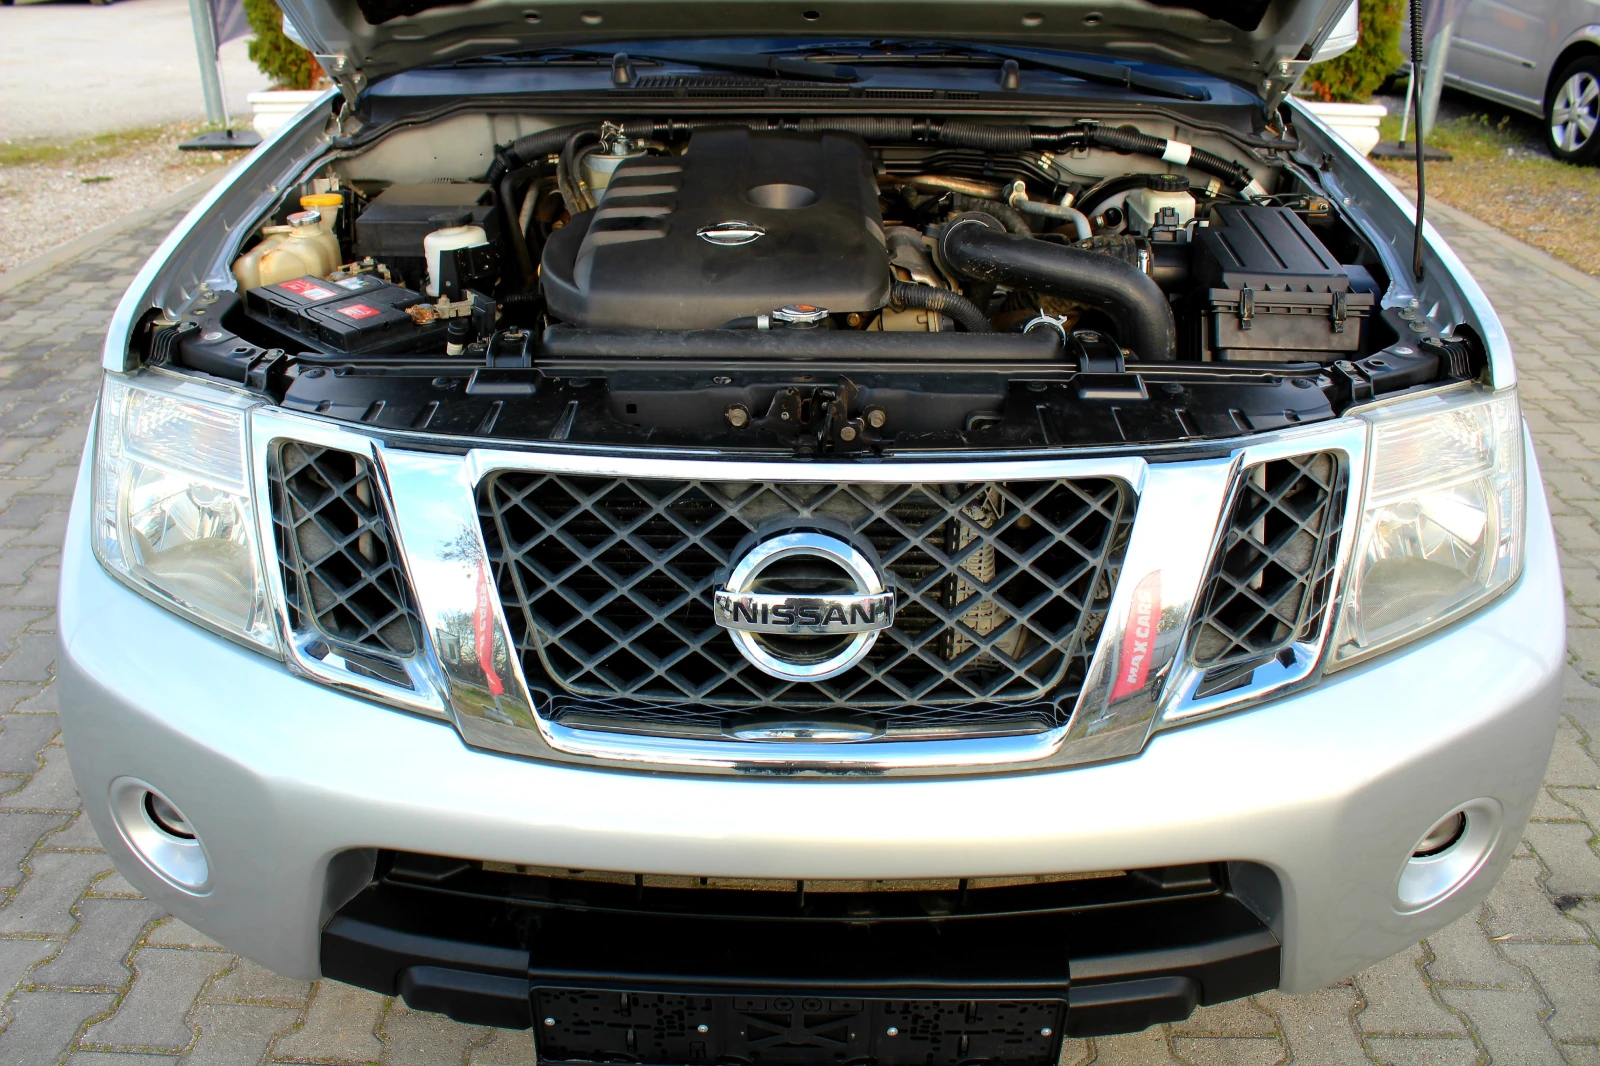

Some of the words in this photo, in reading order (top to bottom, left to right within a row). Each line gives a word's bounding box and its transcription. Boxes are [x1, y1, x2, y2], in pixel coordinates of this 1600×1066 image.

[732, 602, 876, 626] NISSAN
[1136, 590, 1152, 638] CARS
[1128, 640, 1148, 683] MAX
